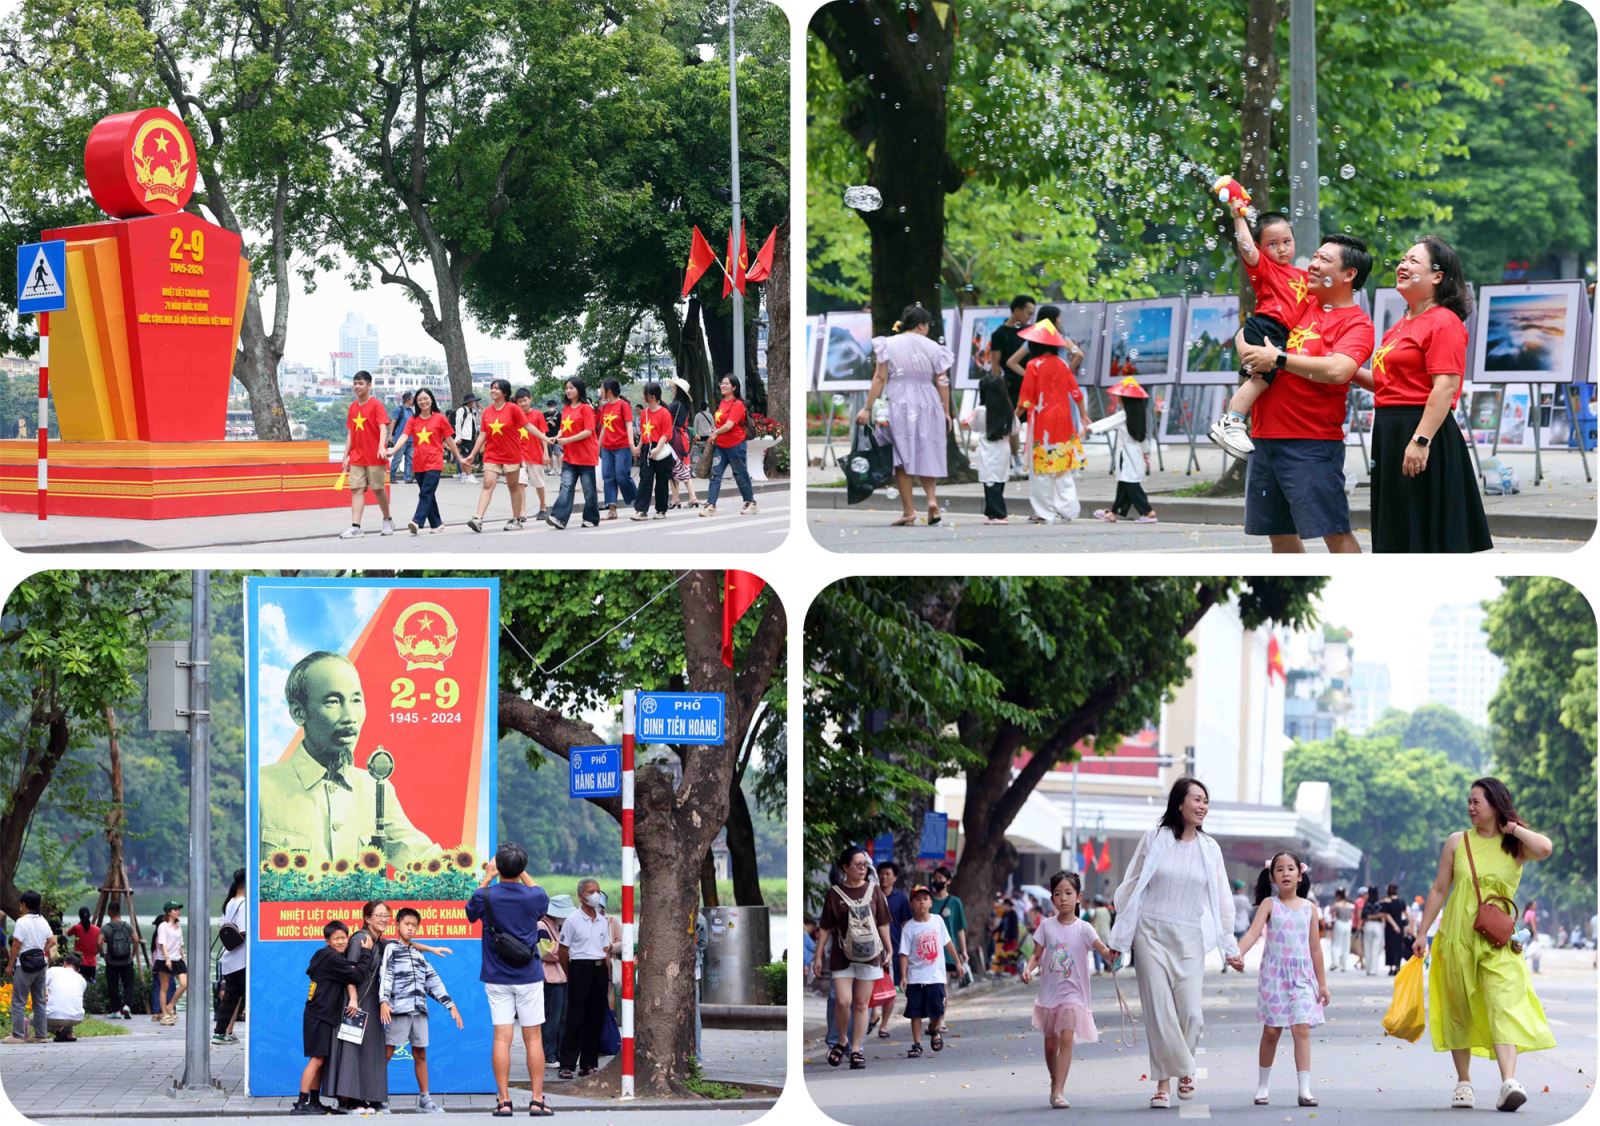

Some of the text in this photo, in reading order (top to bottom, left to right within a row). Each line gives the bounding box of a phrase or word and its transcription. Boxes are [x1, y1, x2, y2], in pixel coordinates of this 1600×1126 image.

[169, 227, 204, 262] 2-9
[169, 262, 204, 275] 1945-2024
[390, 677, 460, 709] 2-9
[674, 697, 702, 711] PHỐ
[389, 712, 419, 723] 1945
[431, 712, 462, 723] 2024
[643, 715, 717, 736] ĐINH TIÊN HOÀNG
[591, 751, 607, 765] PHỐ
[574, 769, 616, 790] HÀNG KHAY
[280, 907, 305, 923] NHIỆT
[307, 907, 324, 923] LIỆT
[326, 906, 350, 920] CHÀO
[416, 904, 438, 919] UỐC
[276, 923, 300, 937] NƯỚC
[384, 921, 396, 935] HỦ
[426, 922, 444, 938] VIỆT
[446, 924, 466, 936] NAM
[469, 925, 472, 935] !
